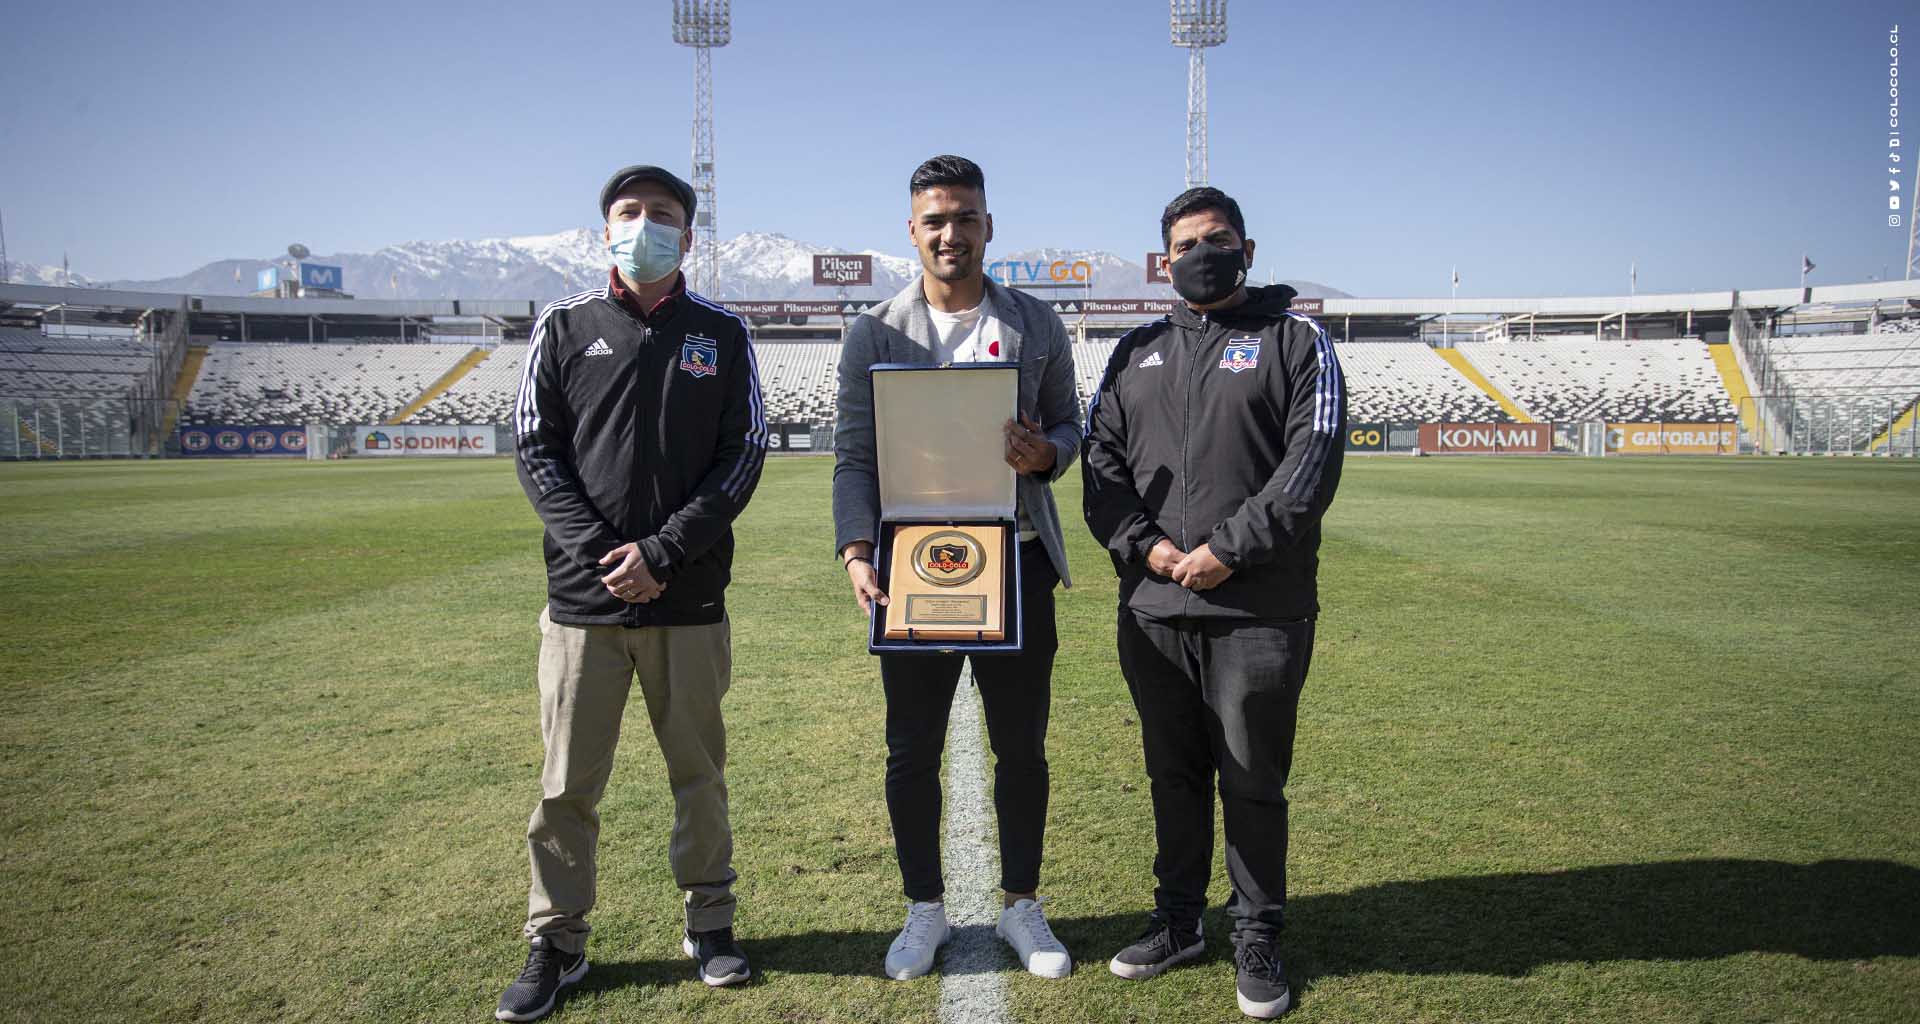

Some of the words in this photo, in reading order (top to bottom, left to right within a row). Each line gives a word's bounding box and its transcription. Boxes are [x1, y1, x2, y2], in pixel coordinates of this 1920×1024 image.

[821, 257, 863, 270] Pilsen
[823, 271, 836, 279] del
[837, 271, 861, 282] Sur
[987, 260, 1042, 283] CTV
[1050, 260, 1092, 282] GO
[723, 303, 752, 312] Pilsen
[762, 303, 779, 313] Sur
[784, 303, 811, 312] Pilsen
[821, 303, 840, 313] Sur
[1083, 302, 1111, 311] Pilsen
[1122, 302, 1138, 312] Sur
[1144, 302, 1172, 311] Pilsen
[584, 348, 614, 357] adidas
[682, 361, 715, 373] COLO-COLO
[393, 435, 484, 449] SODIMAC
[1350, 429, 1381, 446] GO
[1438, 429, 1537, 447] KONAMI
[1632, 431, 1732, 446] GATORADE
